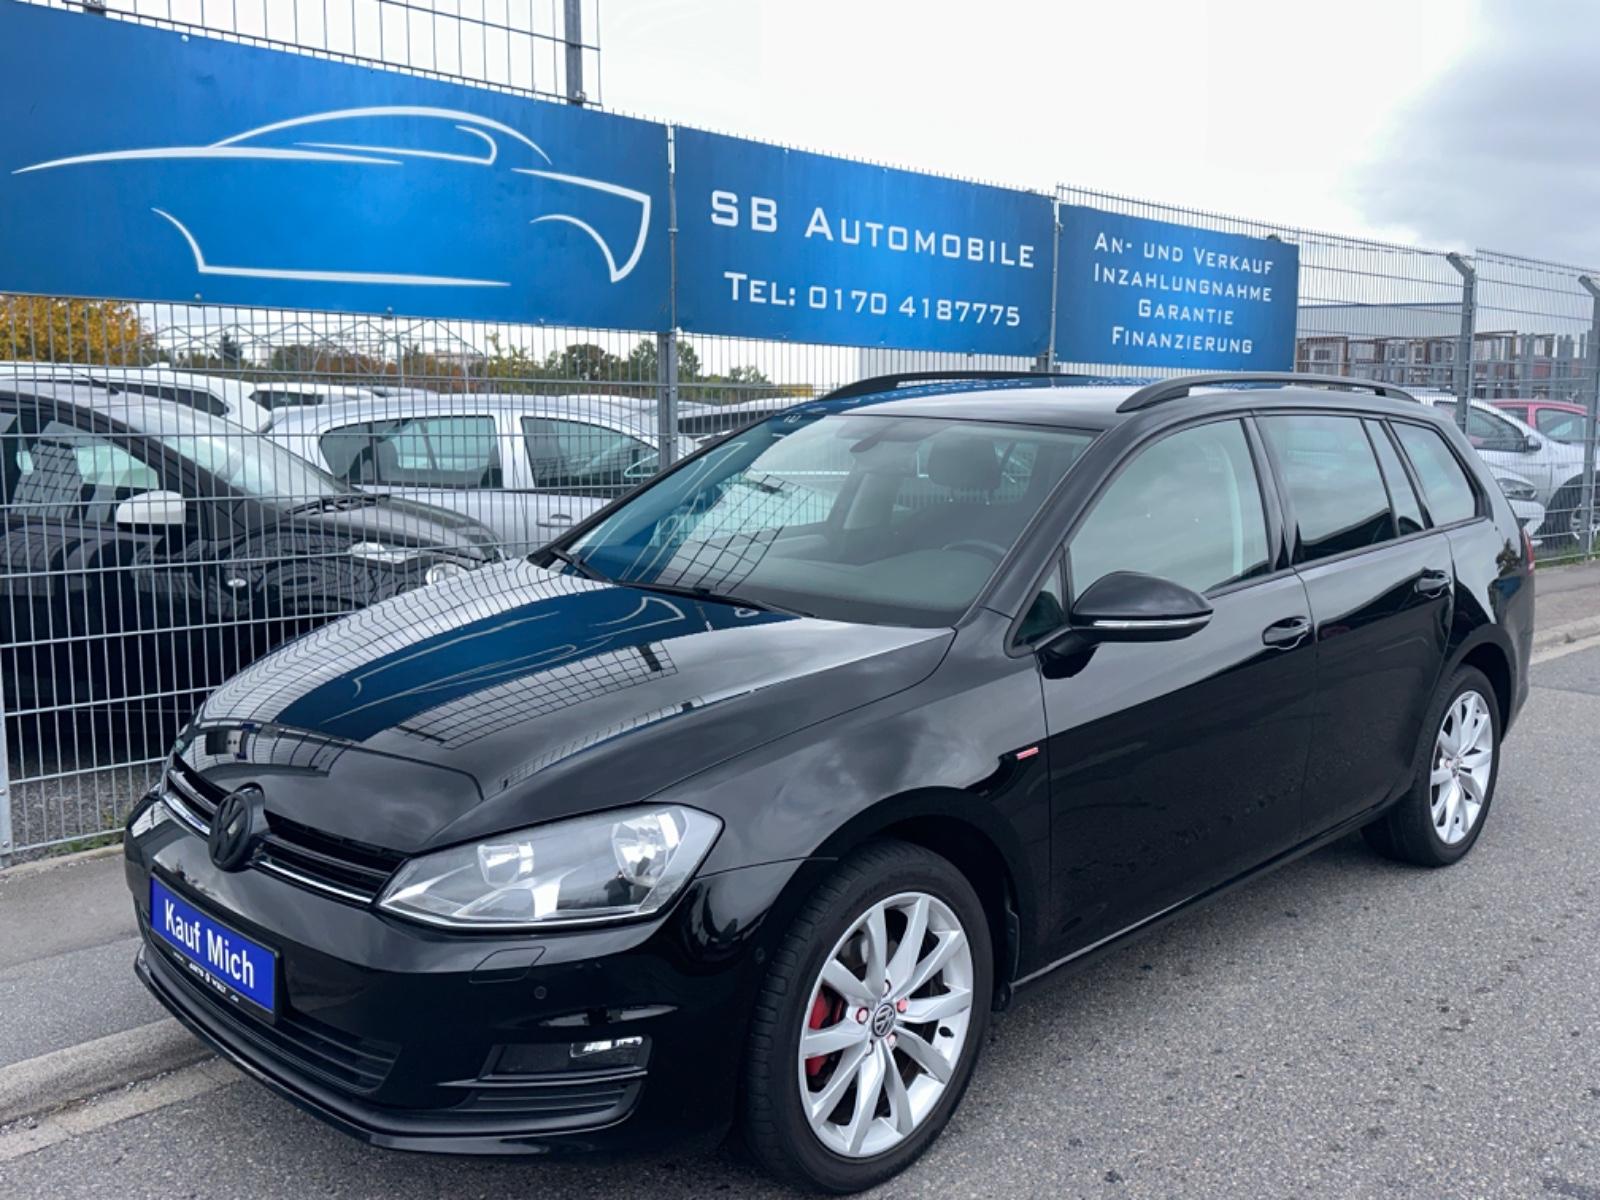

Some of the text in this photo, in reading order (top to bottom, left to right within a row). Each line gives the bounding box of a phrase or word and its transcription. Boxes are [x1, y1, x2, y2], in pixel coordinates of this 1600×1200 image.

[710, 189, 1035, 269] SB AUTOMOBILE
[1094, 232, 1274, 275] AN- UND VERKAUF
[723, 271, 1021, 327] TEL: 0170 4187775
[1094, 263, 1273, 303] INZAHLUNGNAHME
[1138, 299, 1235, 326] GARANTIE
[1111, 326, 1254, 355] FINANZIERUNG
[164, 898, 201, 954] Kauf
[206, 928, 255, 990] Mich
